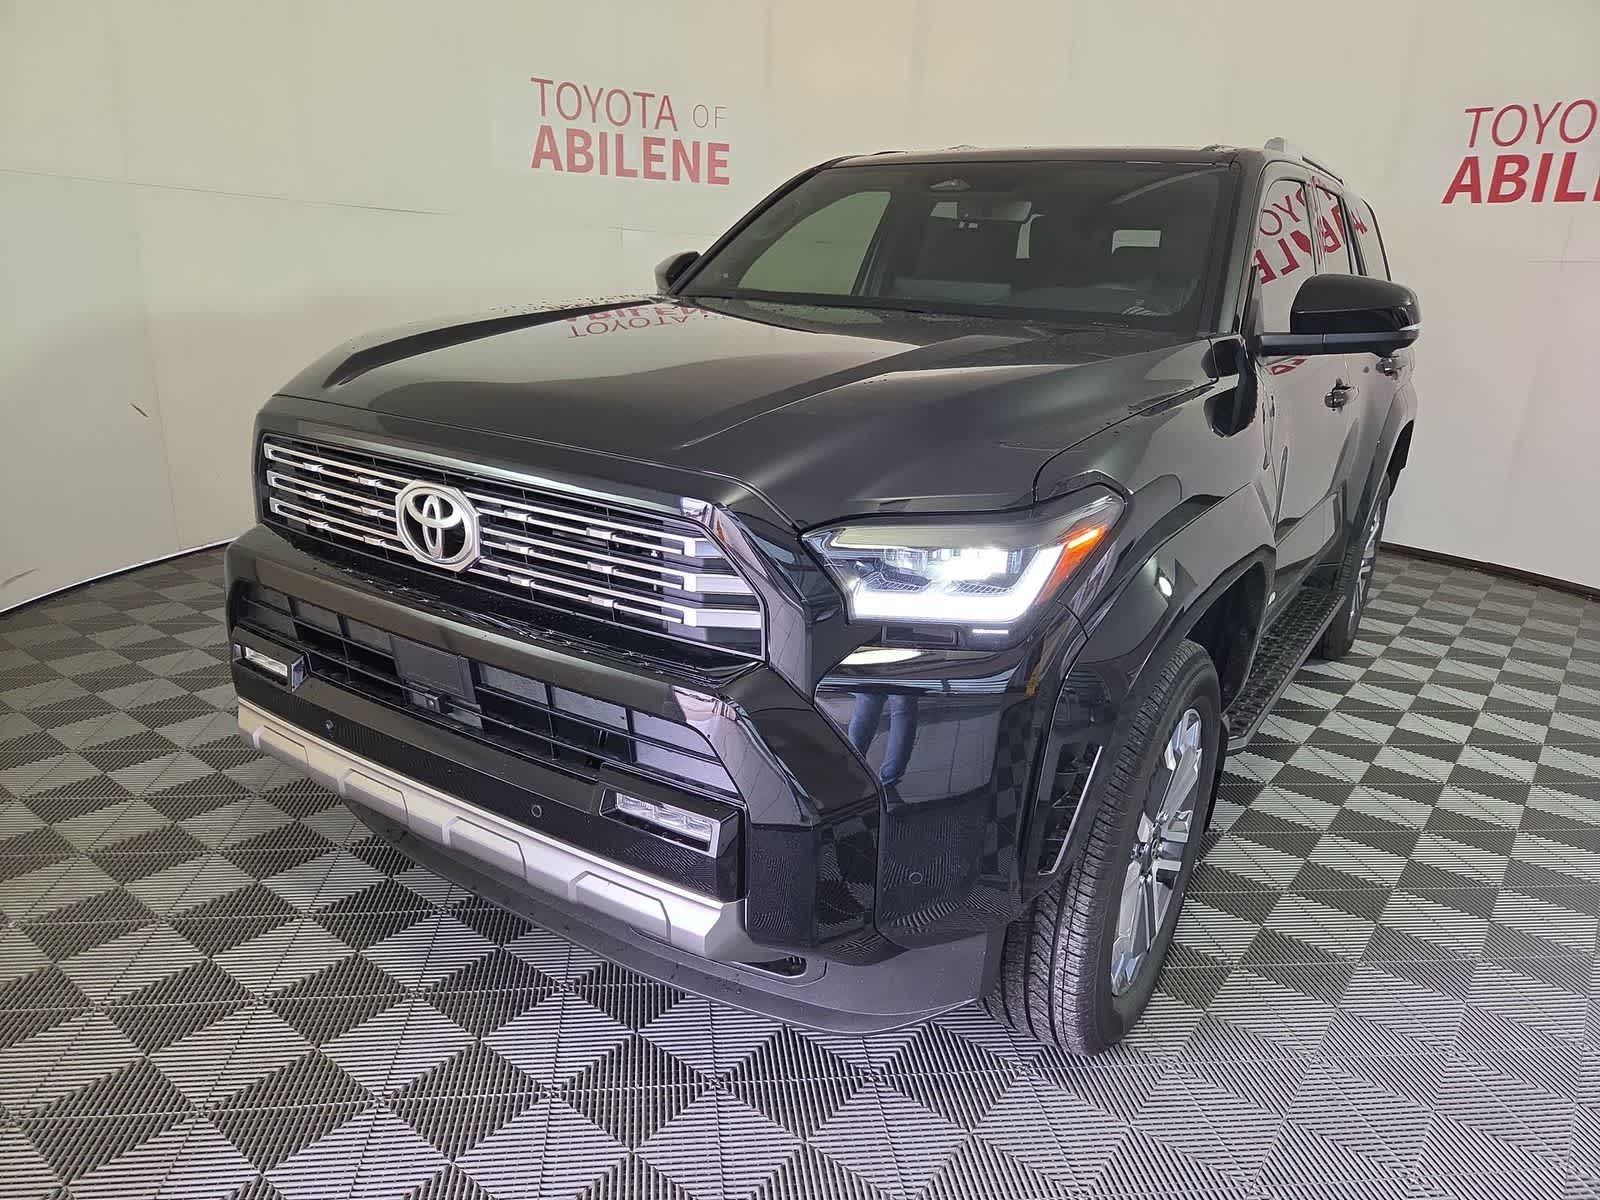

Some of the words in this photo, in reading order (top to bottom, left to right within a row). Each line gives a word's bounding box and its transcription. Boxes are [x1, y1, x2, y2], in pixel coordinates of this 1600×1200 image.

[530, 77, 678, 132] TOYOTA
[692, 104, 727, 129] OF
[530, 124, 730, 185] ABILENE
[1441, 152, 1600, 204] ABIL
